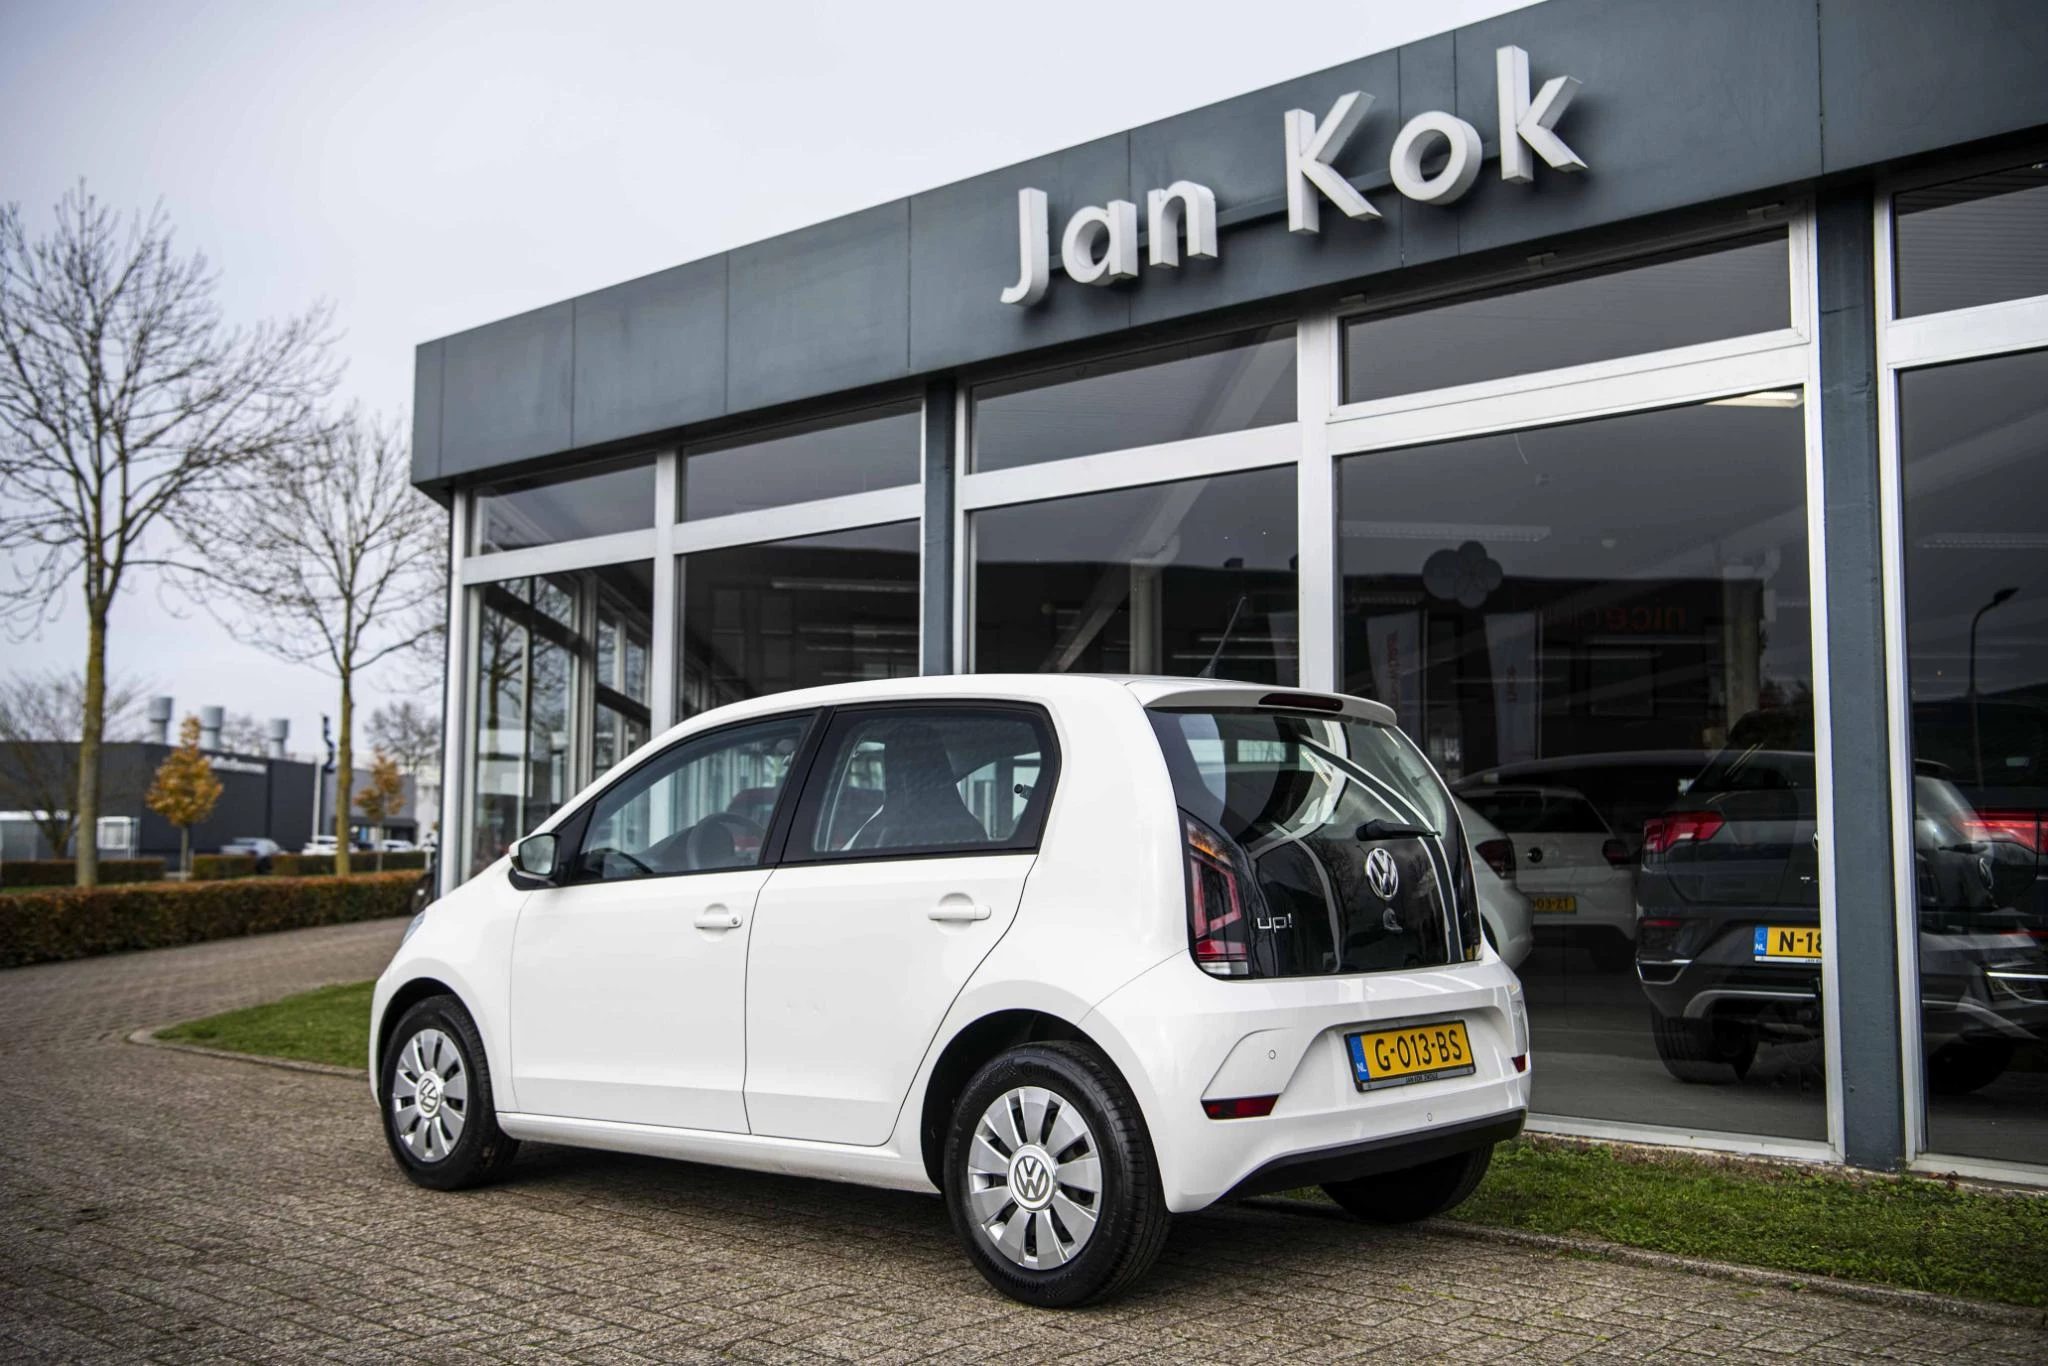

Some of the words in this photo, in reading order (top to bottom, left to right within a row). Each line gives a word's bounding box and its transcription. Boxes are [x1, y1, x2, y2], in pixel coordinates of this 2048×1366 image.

[1000, 180, 1218, 305] Jan
[1285, 45, 1588, 234] Kok
[1257, 913, 1292, 933] up!
[1755, 943, 1765, 951] NL
[1356, 1062, 1367, 1072] NL
[1375, 1029, 1462, 1071] G-013-BS
